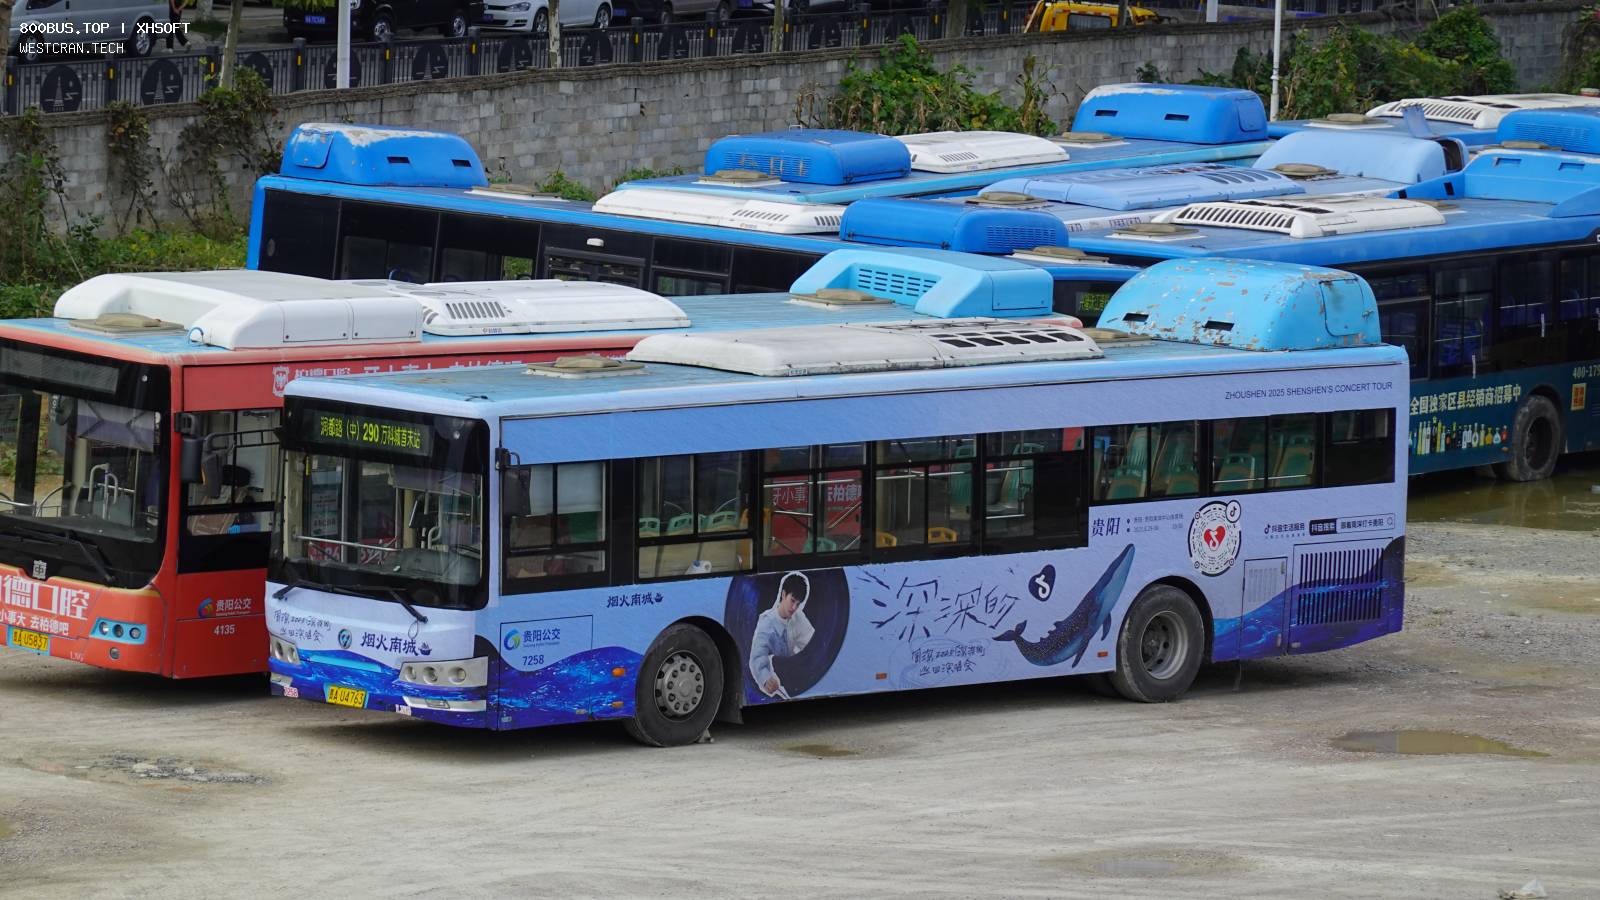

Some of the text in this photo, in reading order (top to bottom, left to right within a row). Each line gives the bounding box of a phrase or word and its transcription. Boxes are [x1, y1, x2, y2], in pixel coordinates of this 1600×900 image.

[1225, 381, 1393, 400] ZHOUSHEN 2025 SHENSHEN'S CONCERT TOUR
[1410, 384, 1521, 416] 全国独家区县经销商招募中
[363, 423, 379, 442] 290
[381, 425, 421, 449] 万科城首末站
[1091, 517, 1121, 537] 贵阳
[0, 574, 90, 621] 德口腔
[216, 598, 251, 611] 贵阳公交
[606, 592, 654, 608] 烟火南城
[30, 616, 69, 636] 去柏德吧
[214, 624, 235, 635] 4135
[522, 627, 561, 643] 贵阳公交
[361, 631, 419, 656] 烟火南城
[522, 654, 544, 666] 7258
